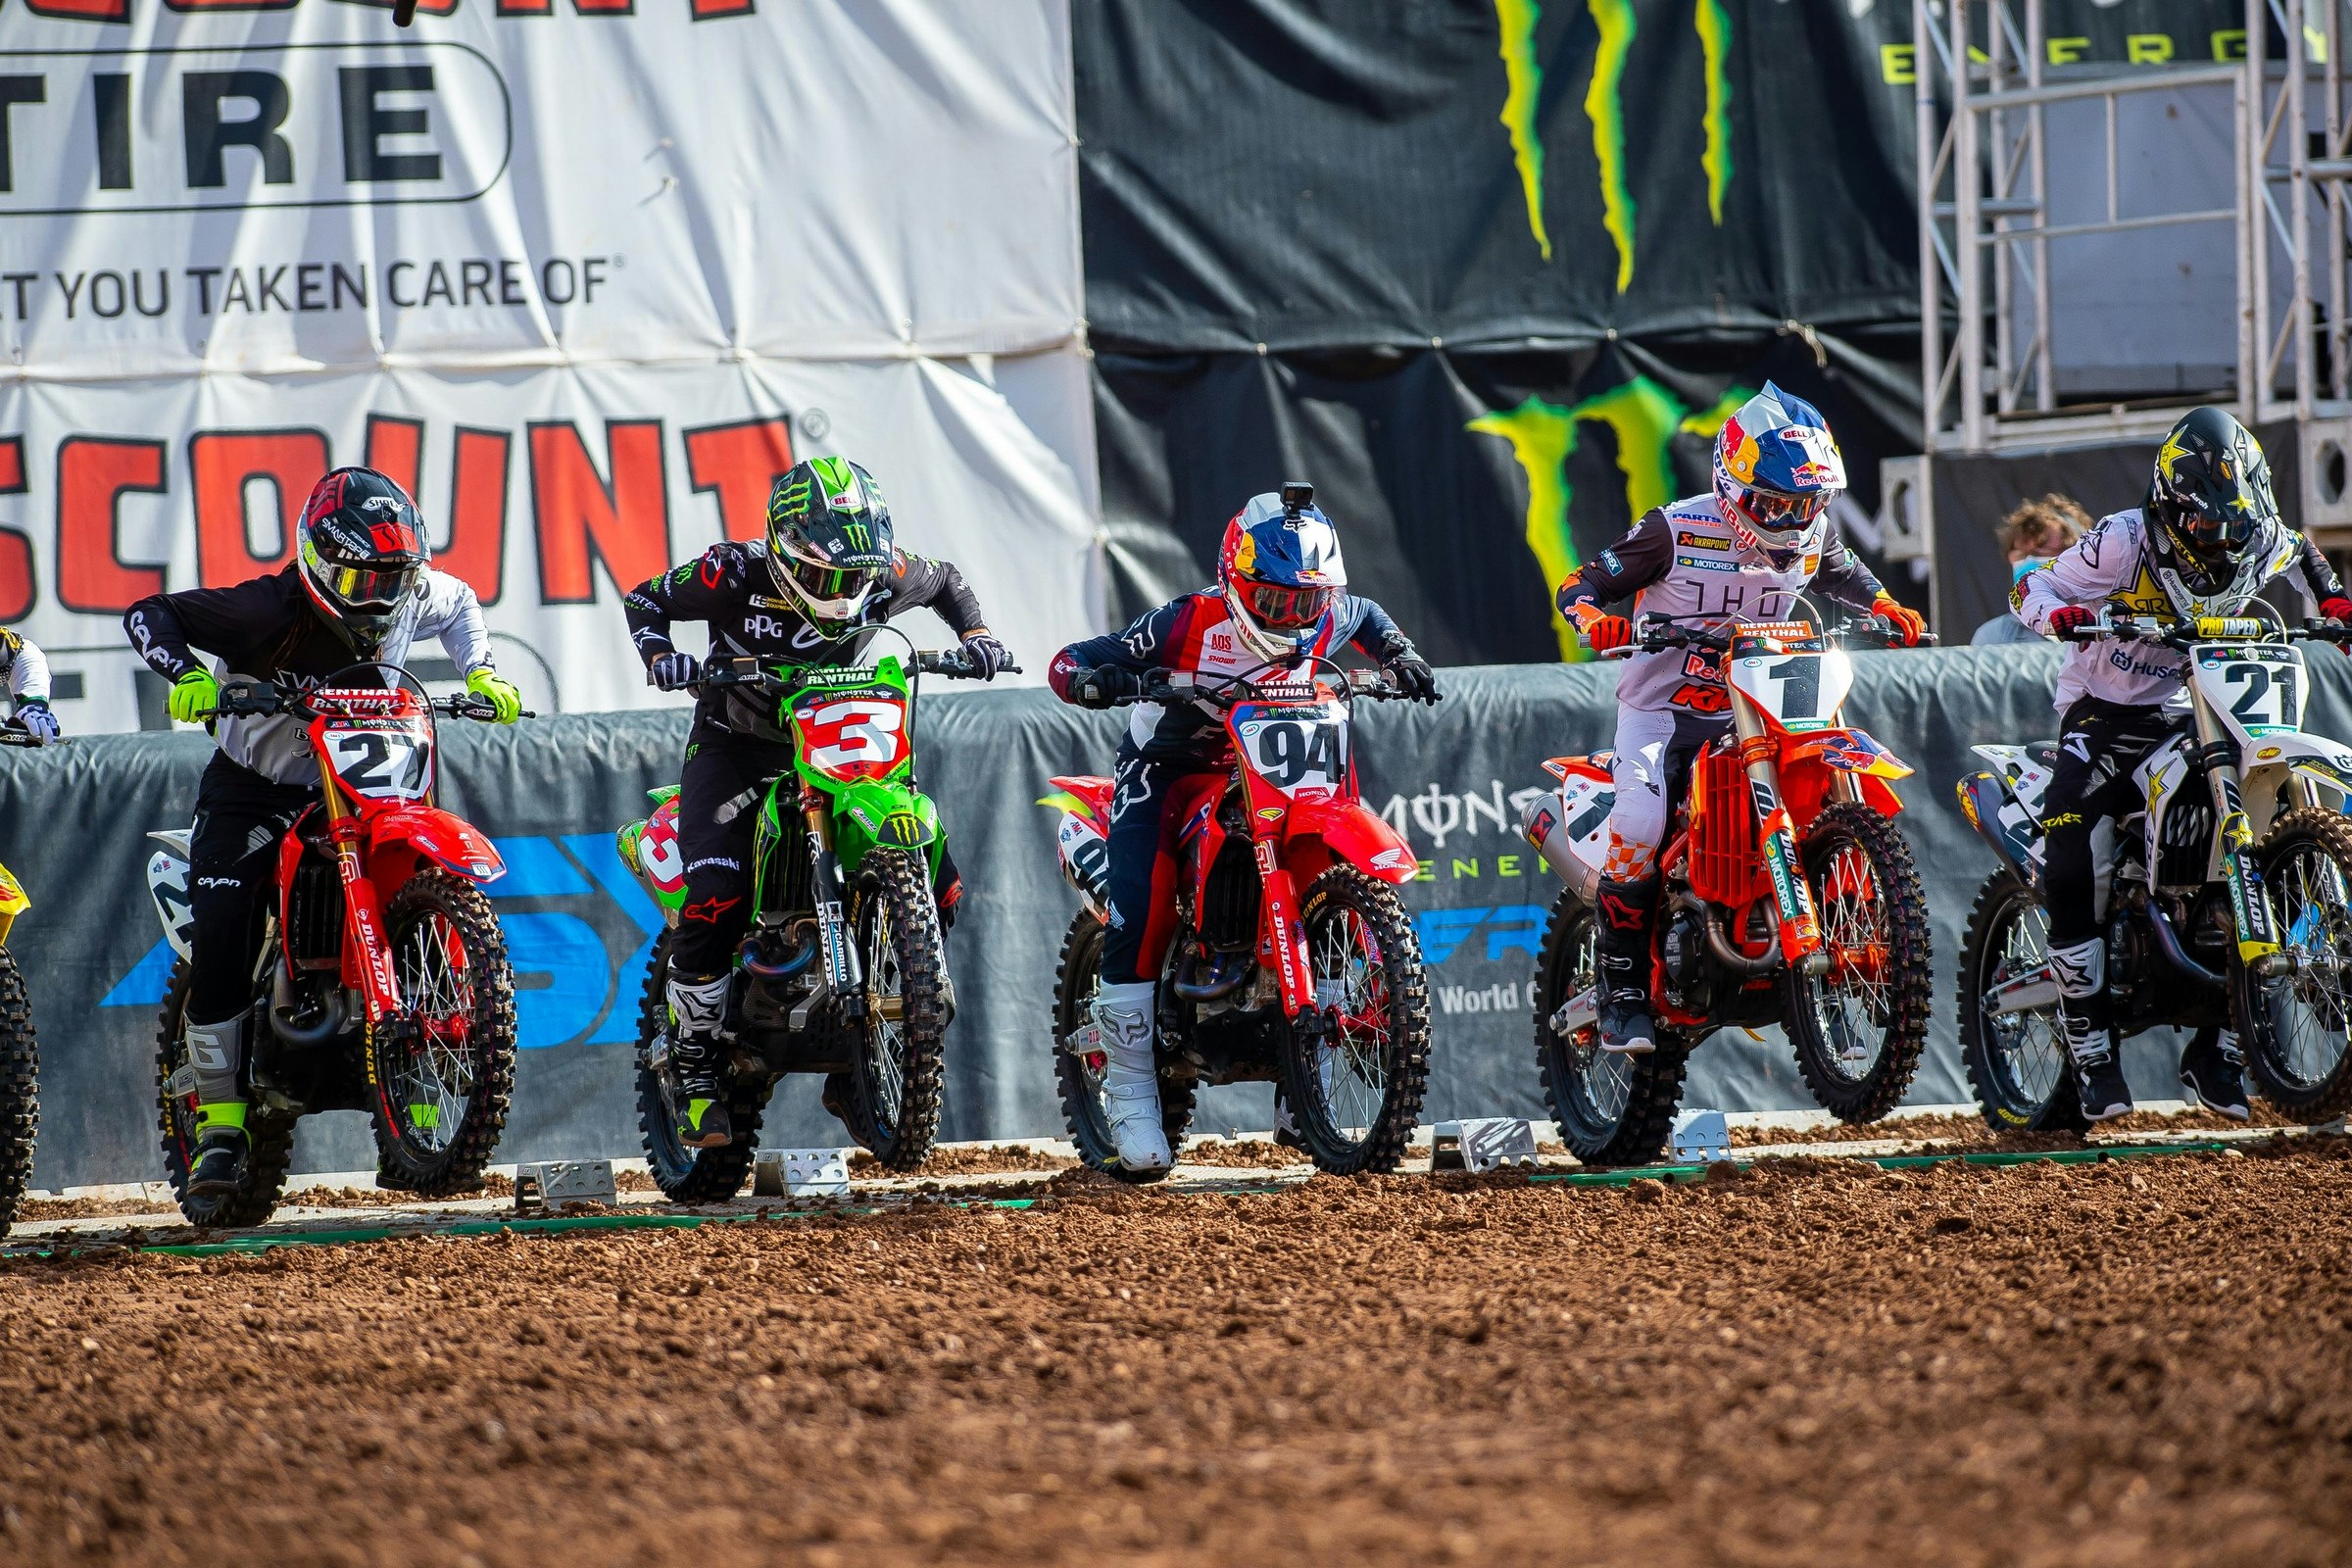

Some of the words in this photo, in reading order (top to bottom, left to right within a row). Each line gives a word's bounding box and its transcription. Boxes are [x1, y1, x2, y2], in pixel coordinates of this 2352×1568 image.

[0, 273, 38, 321] T
[55, 268, 171, 320] YOU
[185, 261, 370, 315] TAKEN
[387, 259, 528, 310] CARE
[1783, 429, 1809, 439] BELL
[1794, 474, 1818, 488] Red
[1819, 474, 1839, 484] Bull
[833, 496, 858, 506] BELL
[2189, 491, 2210, 511] Airoh
[1672, 512, 1723, 523] PARTS
[1672, 517, 1723, 529] UNLIMITED
[842, 553, 888, 564] MONSTER
[1693, 558, 1737, 572] MOTOREX
[1685, 579, 1805, 616] THO
[1206, 655, 1237, 665] SHOWA
[807, 672, 876, 685] RENTHAL
[1768, 656, 1822, 720] 1
[832, 689, 875, 699] MONSTER
[2225, 662, 2298, 726] 21
[809, 700, 904, 771] 3
[1795, 720, 1826, 729] MOTOREX
[1258, 721, 1346, 788] 94
[808, 764, 841, 787] Kawasaki
[883, 760, 909, 782] Kawasaki
[1298, 790, 1327, 799] HONDA
[686, 857, 741, 874] Kawasaki
[1373, 861, 1413, 871] HONDA
[1769, 856, 1794, 919] MOTOREX
[2228, 875, 2251, 940] MOTOREX
[816, 902, 834, 987] DUNLOP
[1273, 915, 1296, 990] DUNLOP
[361, 923, 390, 998] DUNLOP
[834, 931, 848, 982] CARRILLO
[1436, 982, 1519, 1015] World
[366, 1021, 378, 1086] DUNLO
